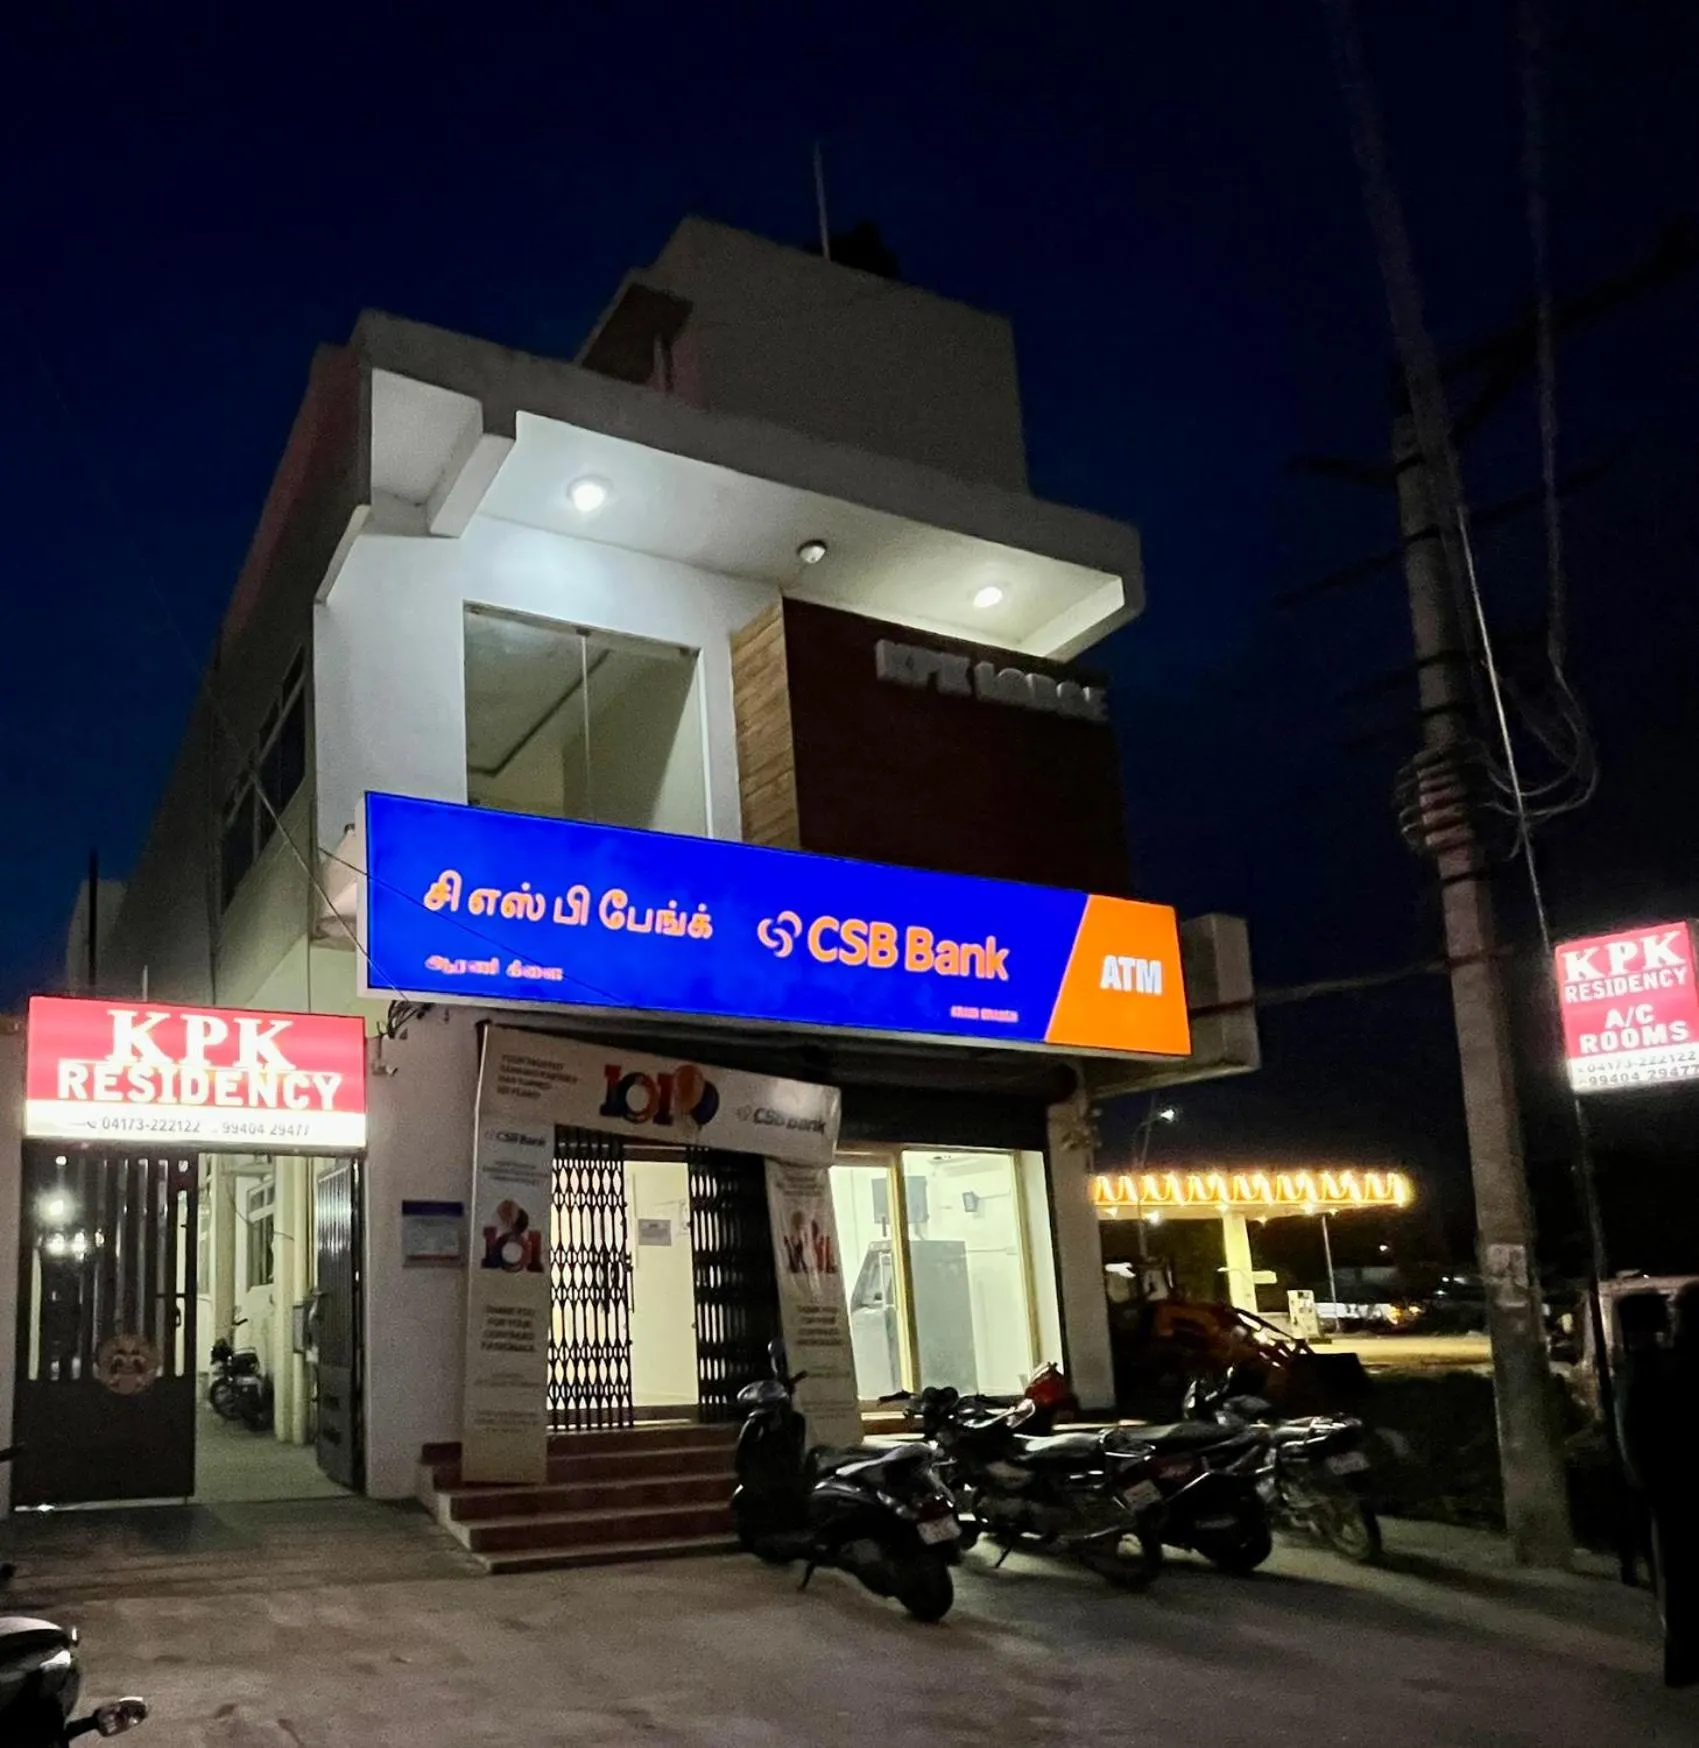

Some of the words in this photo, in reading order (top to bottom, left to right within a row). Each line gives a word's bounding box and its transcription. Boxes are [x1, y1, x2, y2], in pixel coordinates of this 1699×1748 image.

[424, 869, 462, 912] சி
[468, 882, 545, 922] எஸ்
[554, 884, 591, 927] பி
[598, 888, 713, 939] பேங்க்
[807, 915, 898, 969] CSB
[904, 926, 1009, 981] Bank
[1563, 931, 1687, 983] KPK
[1100, 954, 1162, 995] ATM
[1564, 966, 1688, 1004] RESIDENCY
[1579, 1020, 1690, 1054] ROOMS
[1605, 1004, 1655, 1029] A/C
[107, 1009, 295, 1071] KPK
[57, 1061, 342, 1110] RESIDENCY
[1588, 1072, 1640, 1086] 99404
[101, 1116, 201, 1134] 04173-222122
[222, 1120, 265, 1135] 99404
